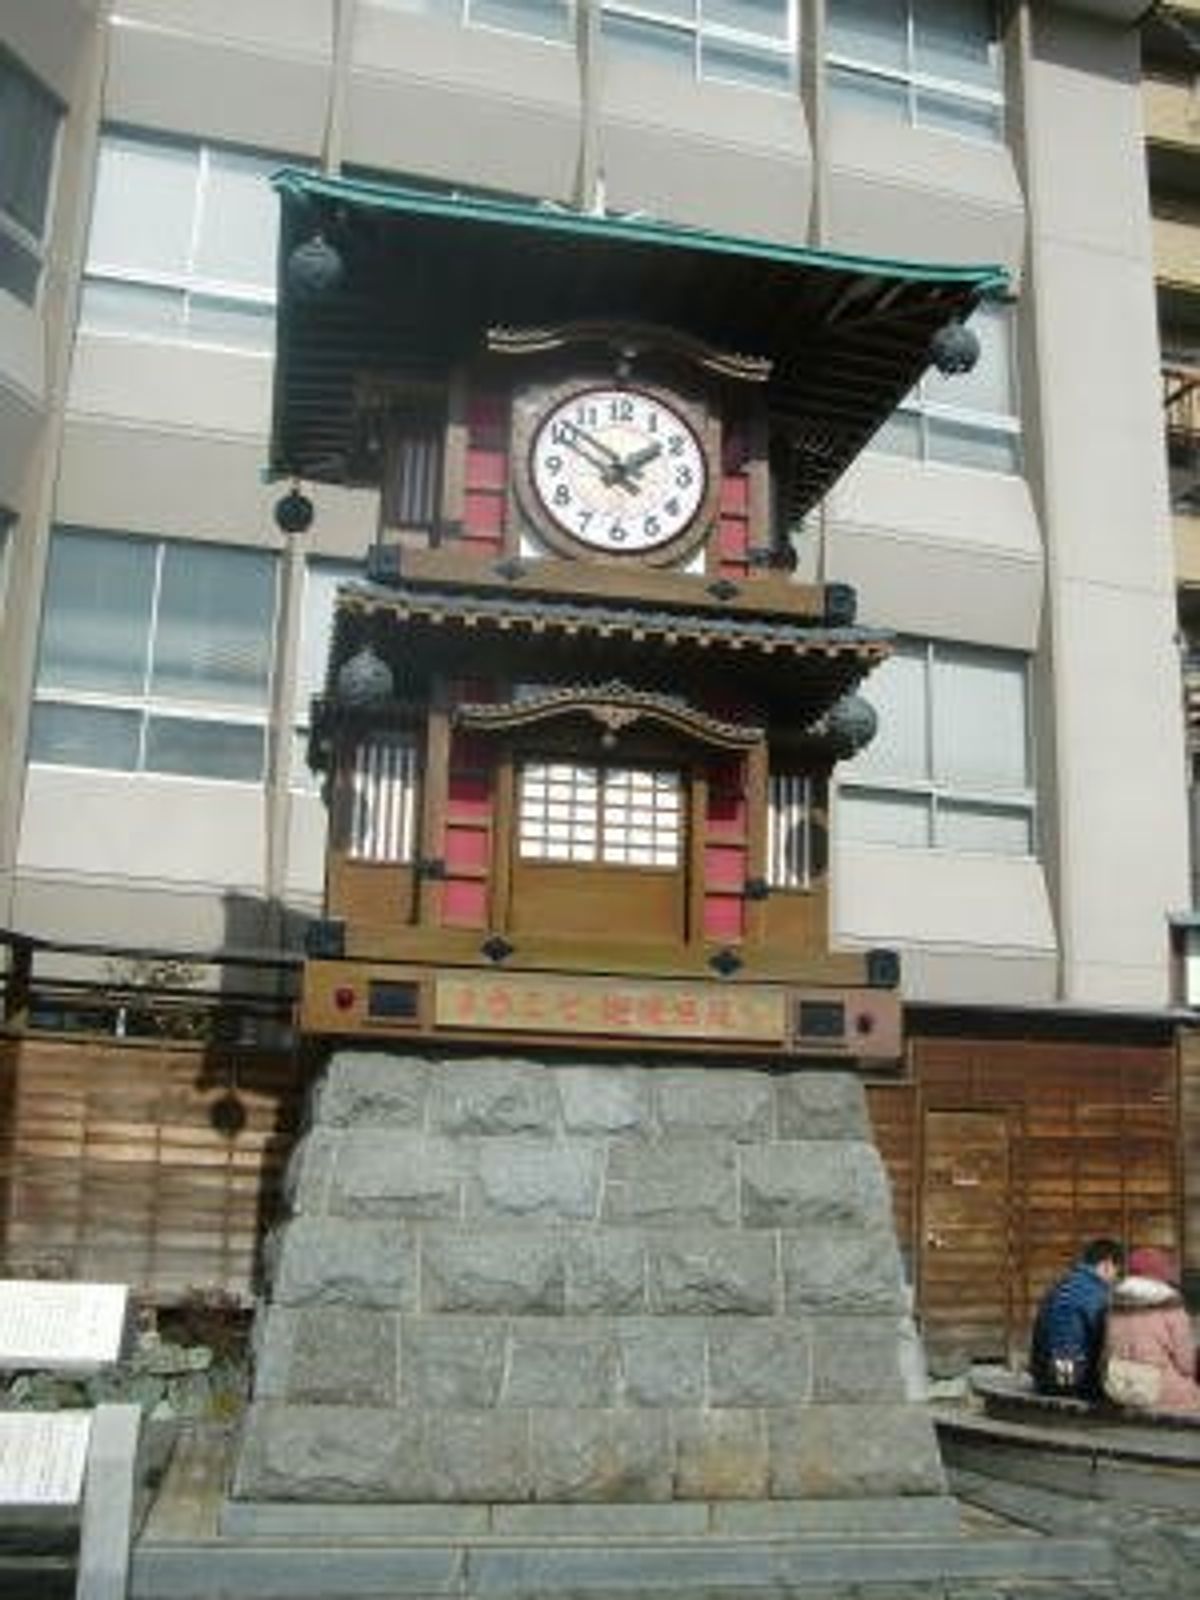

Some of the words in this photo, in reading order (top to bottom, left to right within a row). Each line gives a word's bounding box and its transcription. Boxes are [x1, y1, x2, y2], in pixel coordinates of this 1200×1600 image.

[577, 407, 597, 425] 11
[609, 400, 634, 421] 12
[648, 413, 657, 432] 1
[668, 435, 685, 456] 2
[545, 456, 562, 476] 9
[676, 465, 692, 489] 3
[553, 485, 571, 505] 8
[664, 498, 679, 516] 4
[578, 512, 593, 532] 7
[609, 519, 627, 541] 6
